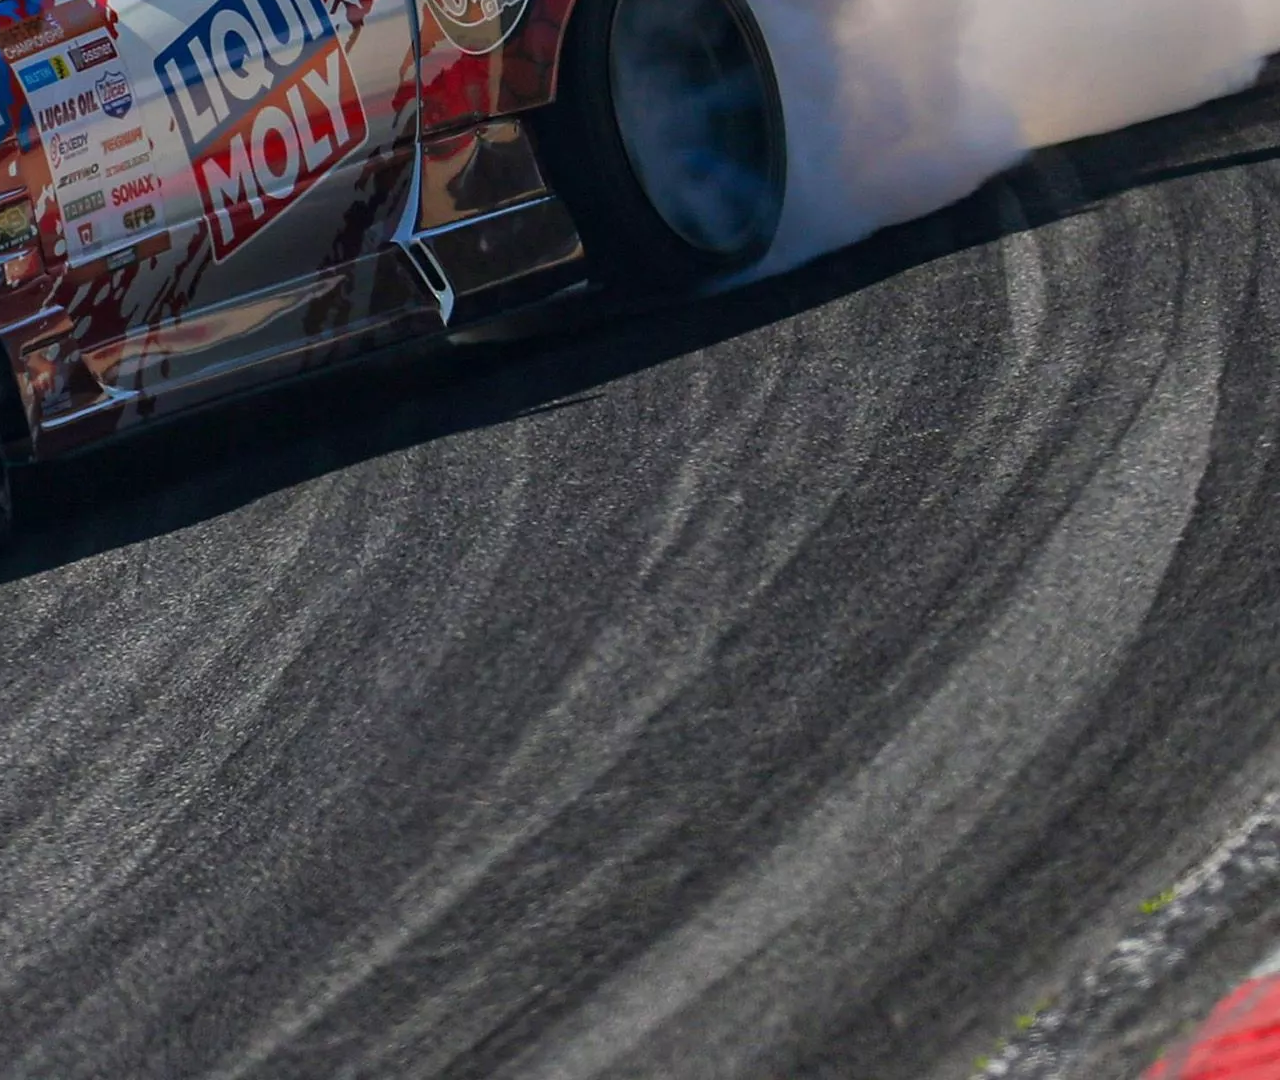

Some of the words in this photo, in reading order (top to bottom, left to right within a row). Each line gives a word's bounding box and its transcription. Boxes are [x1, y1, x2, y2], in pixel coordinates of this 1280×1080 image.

[39, 97, 77, 132] LUCAS
[78, 89, 100, 116] OIL
[202, 47, 350, 246] MOLY
[111, 173, 155, 207] SONAX
